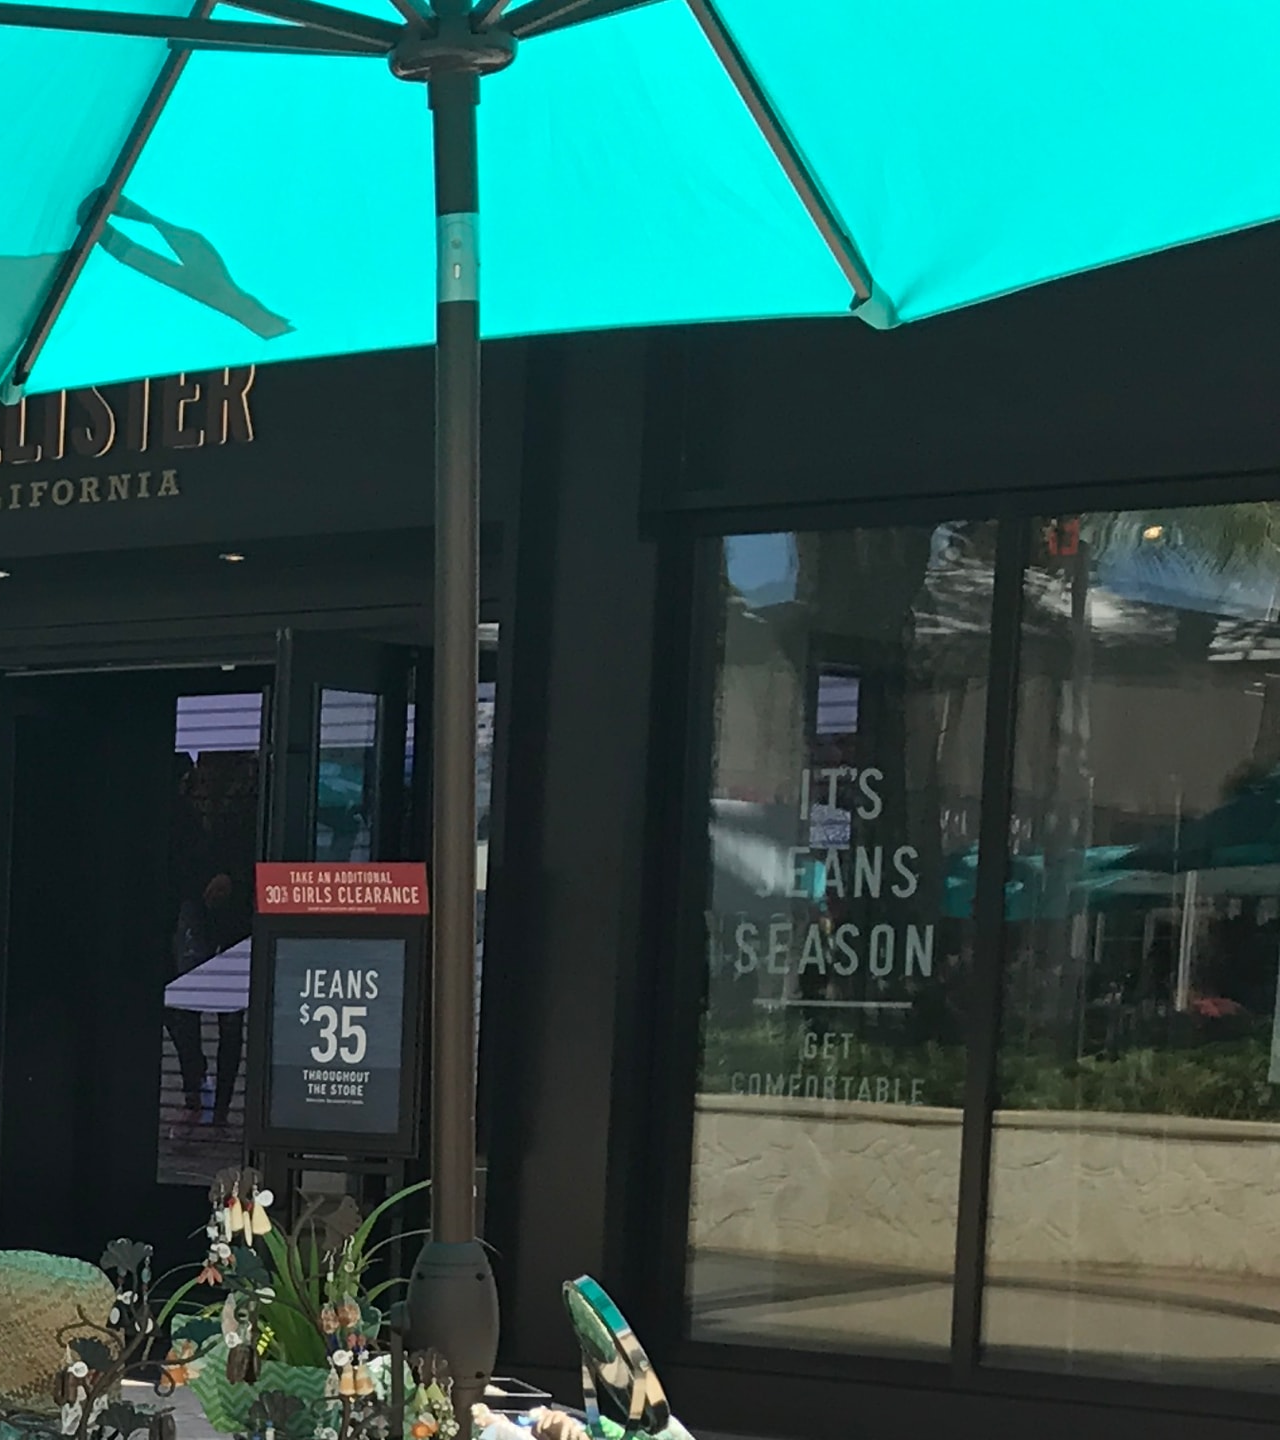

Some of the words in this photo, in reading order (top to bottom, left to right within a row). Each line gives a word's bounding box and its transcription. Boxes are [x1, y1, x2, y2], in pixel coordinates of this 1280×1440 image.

[799, 767, 884, 821] IT'S
[290, 871, 314, 884] TAKE
[317, 871, 332, 884] AN
[334, 871, 393, 884] ADDITIONAL
[755, 844, 920, 899] JEANS
[292, 886, 333, 904] GIRLS
[338, 886, 420, 904] CLEARANCE
[734, 922, 935, 978] SEASON
[300, 968, 379, 999] JEANS
[299, 1002, 368, 1064] $35
[803, 1032, 855, 1060] GET
[302, 1069, 371, 1083] THROUGHOUT
[307, 1083, 327, 1095] THE
[330, 1084, 364, 1097] STORE
[731, 1071, 926, 1106] COMFORTABLE
